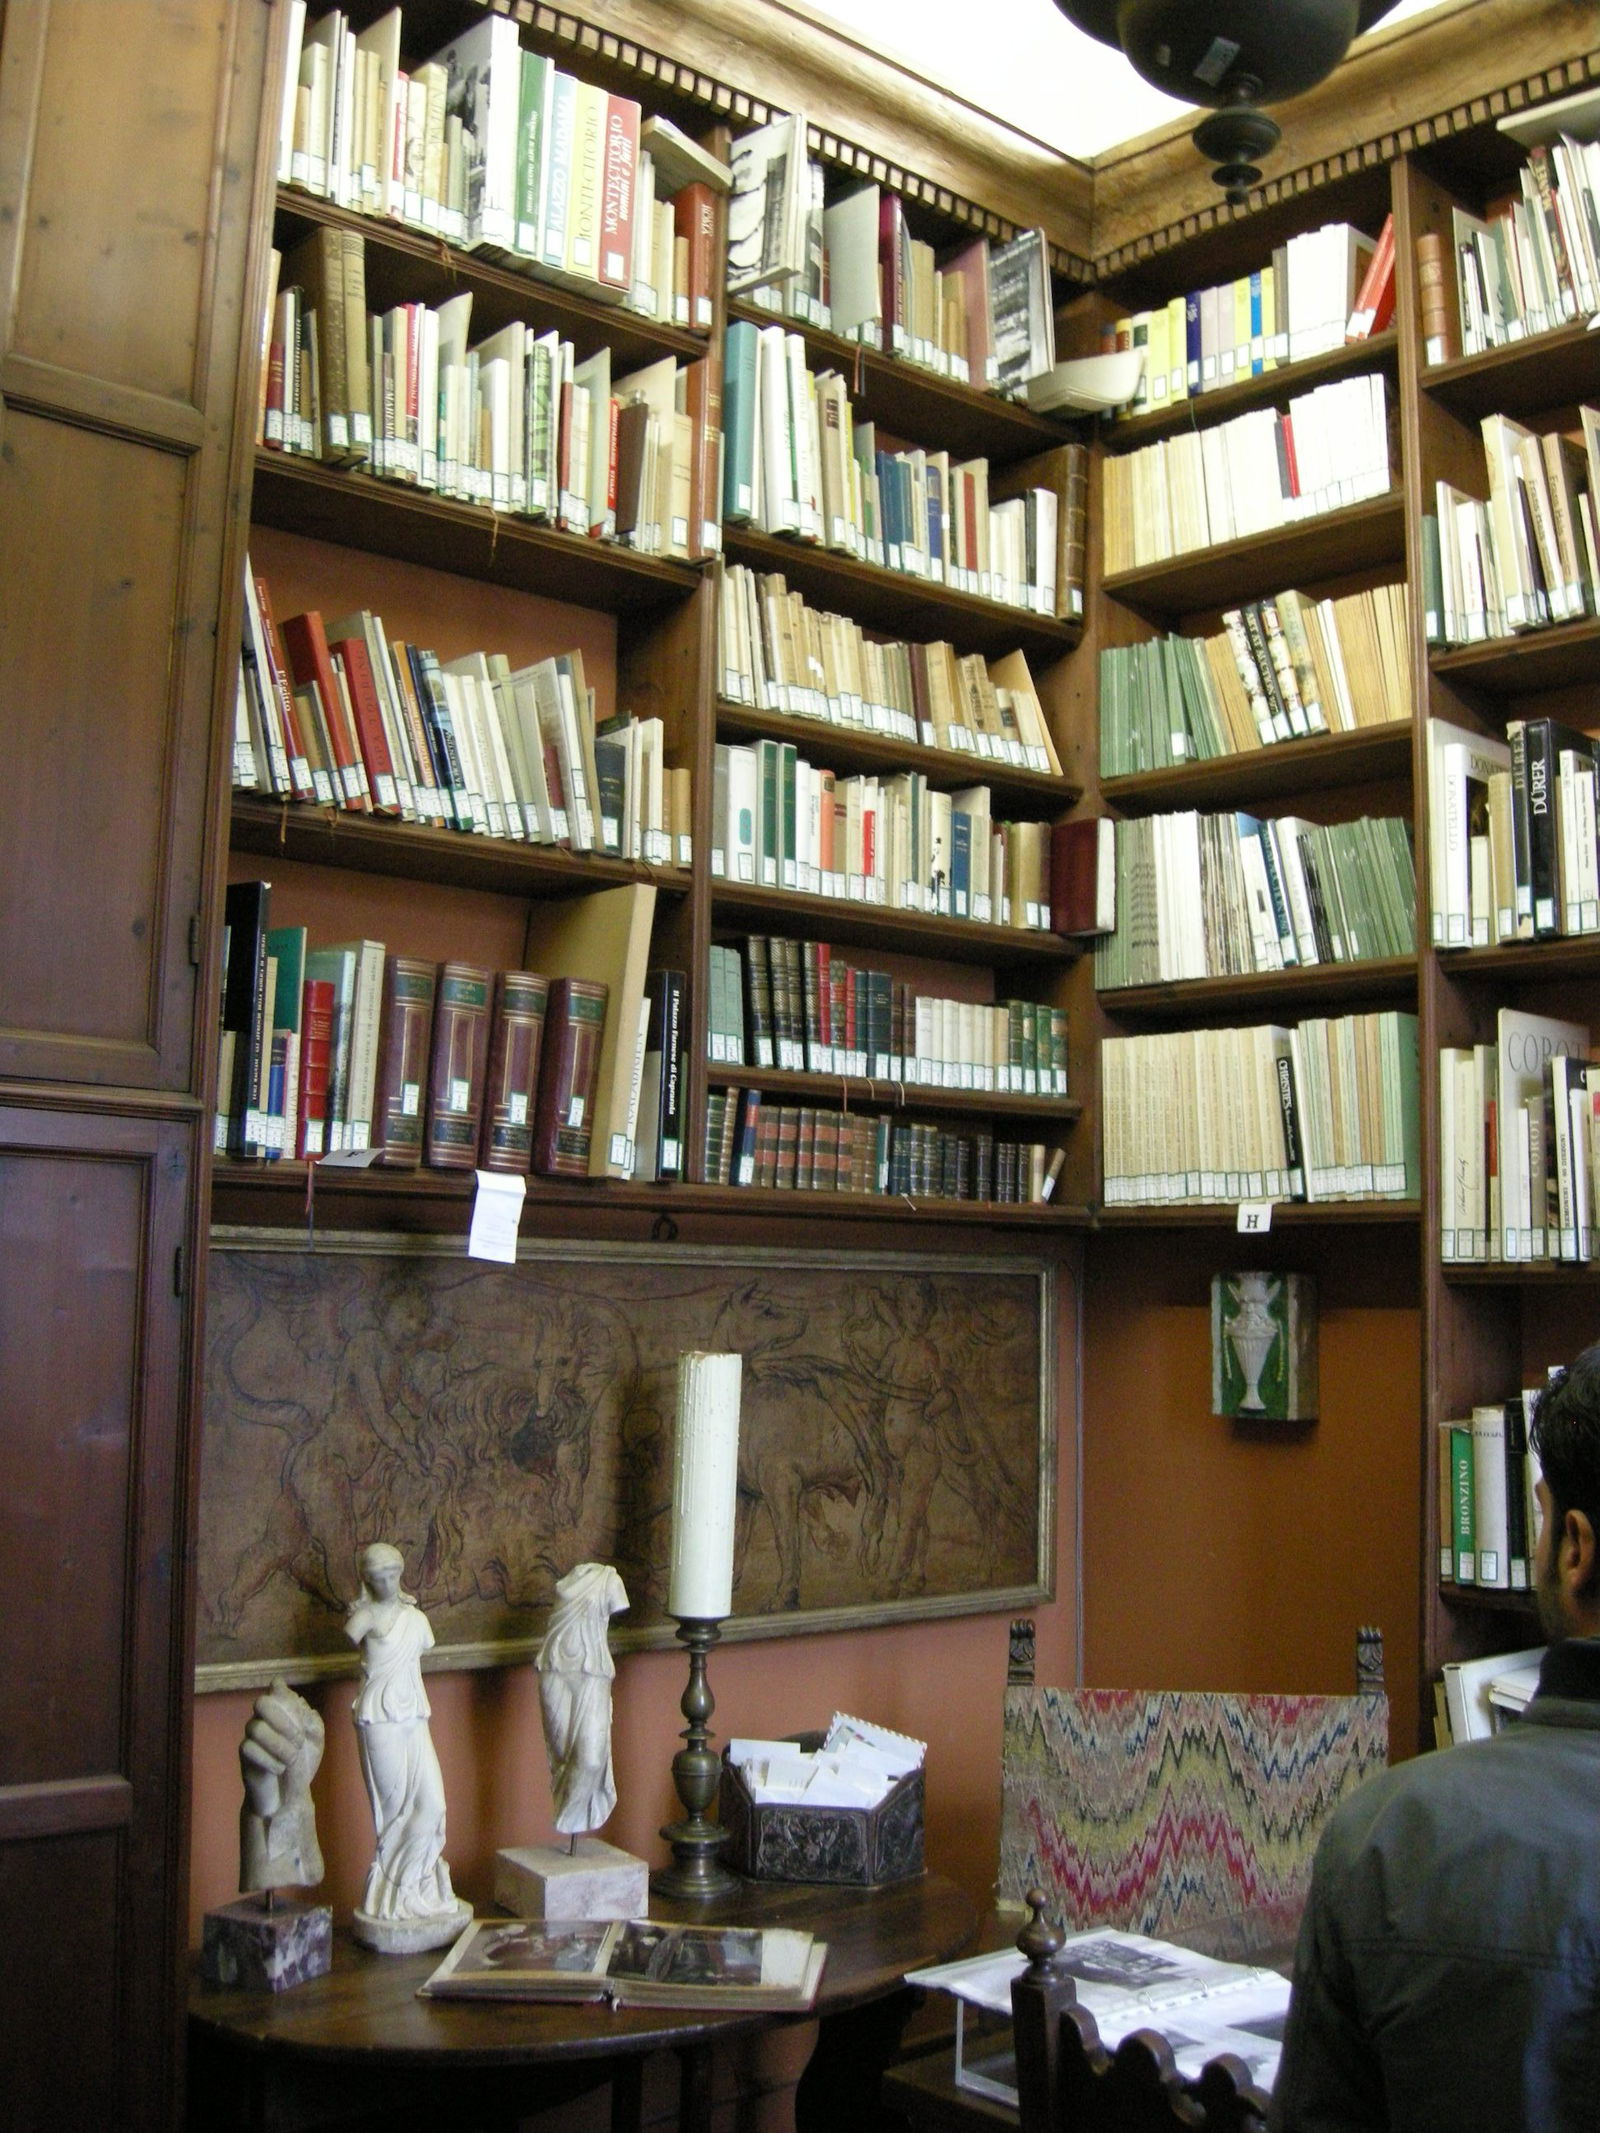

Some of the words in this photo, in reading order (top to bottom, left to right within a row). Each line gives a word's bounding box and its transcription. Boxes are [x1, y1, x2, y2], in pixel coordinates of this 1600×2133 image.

[622, 137, 633, 168] fatti
[605, 115, 623, 235] MONTECITORIO
[622, 168, 631, 179] e
[619, 180, 631, 222] uomini
[1246, 612, 1258, 634] ART
[1255, 648, 1274, 695] AUCTION
[277, 670, 292, 712] L'Egitto
[1448, 774, 1459, 852] DONATELLO
[671, 996, 679, 1028] Palazzo
[670, 1030, 679, 1062] Farnese
[670, 1064, 677, 1075] di
[668, 1075, 678, 1115] Caprarola
[1245, 1214, 1259, 1230] H
[1458, 1460, 1470, 1535] BRONZINO
